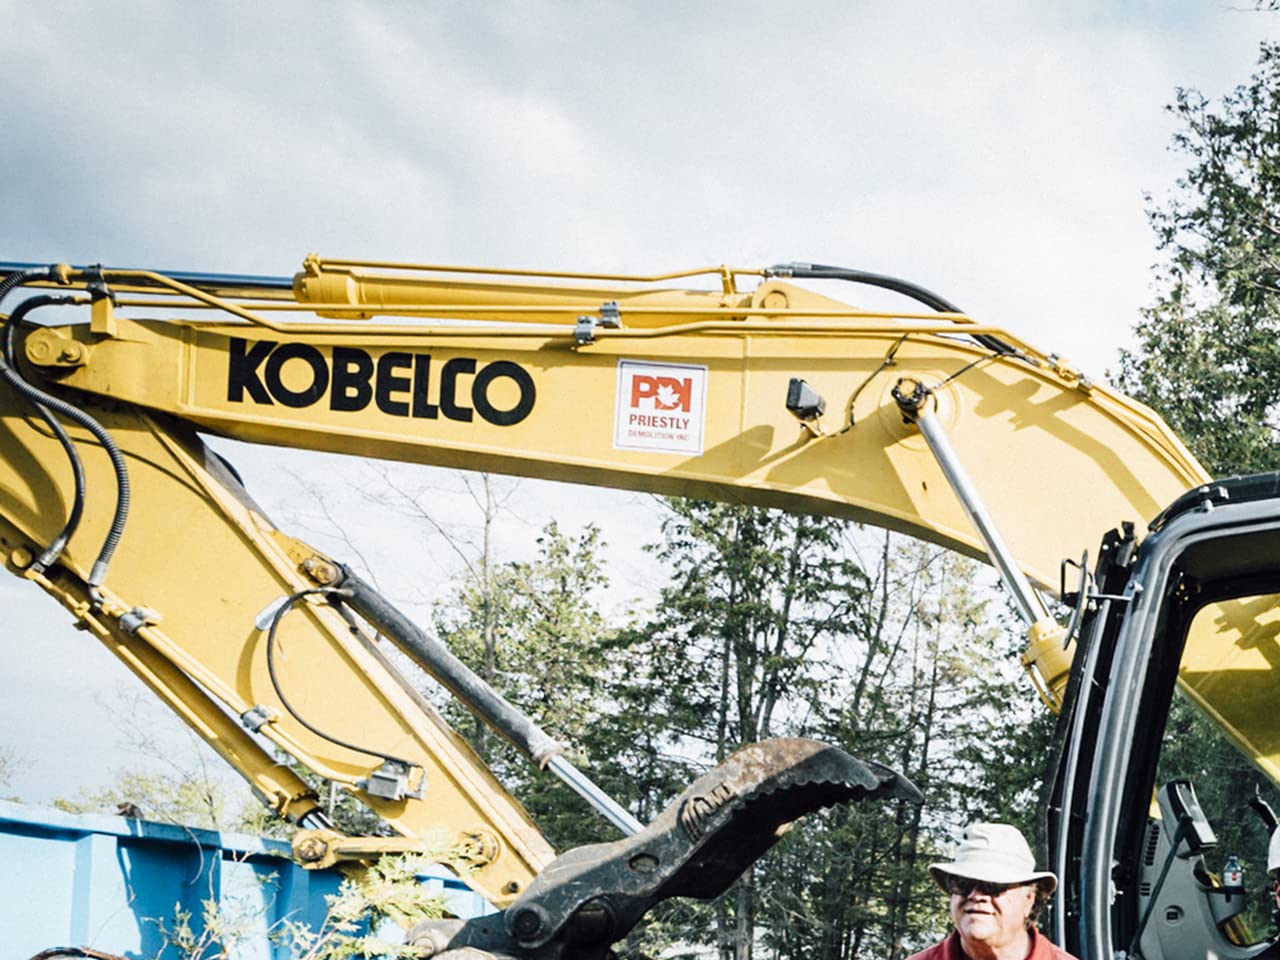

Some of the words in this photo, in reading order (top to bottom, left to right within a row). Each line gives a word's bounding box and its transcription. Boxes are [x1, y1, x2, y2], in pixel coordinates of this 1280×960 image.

[227, 337, 536, 426] KOBELCO
[630, 374, 692, 413] PDI
[627, 429, 674, 440] DEMOLITION
[629, 413, 690, 430] PRIESTLY
